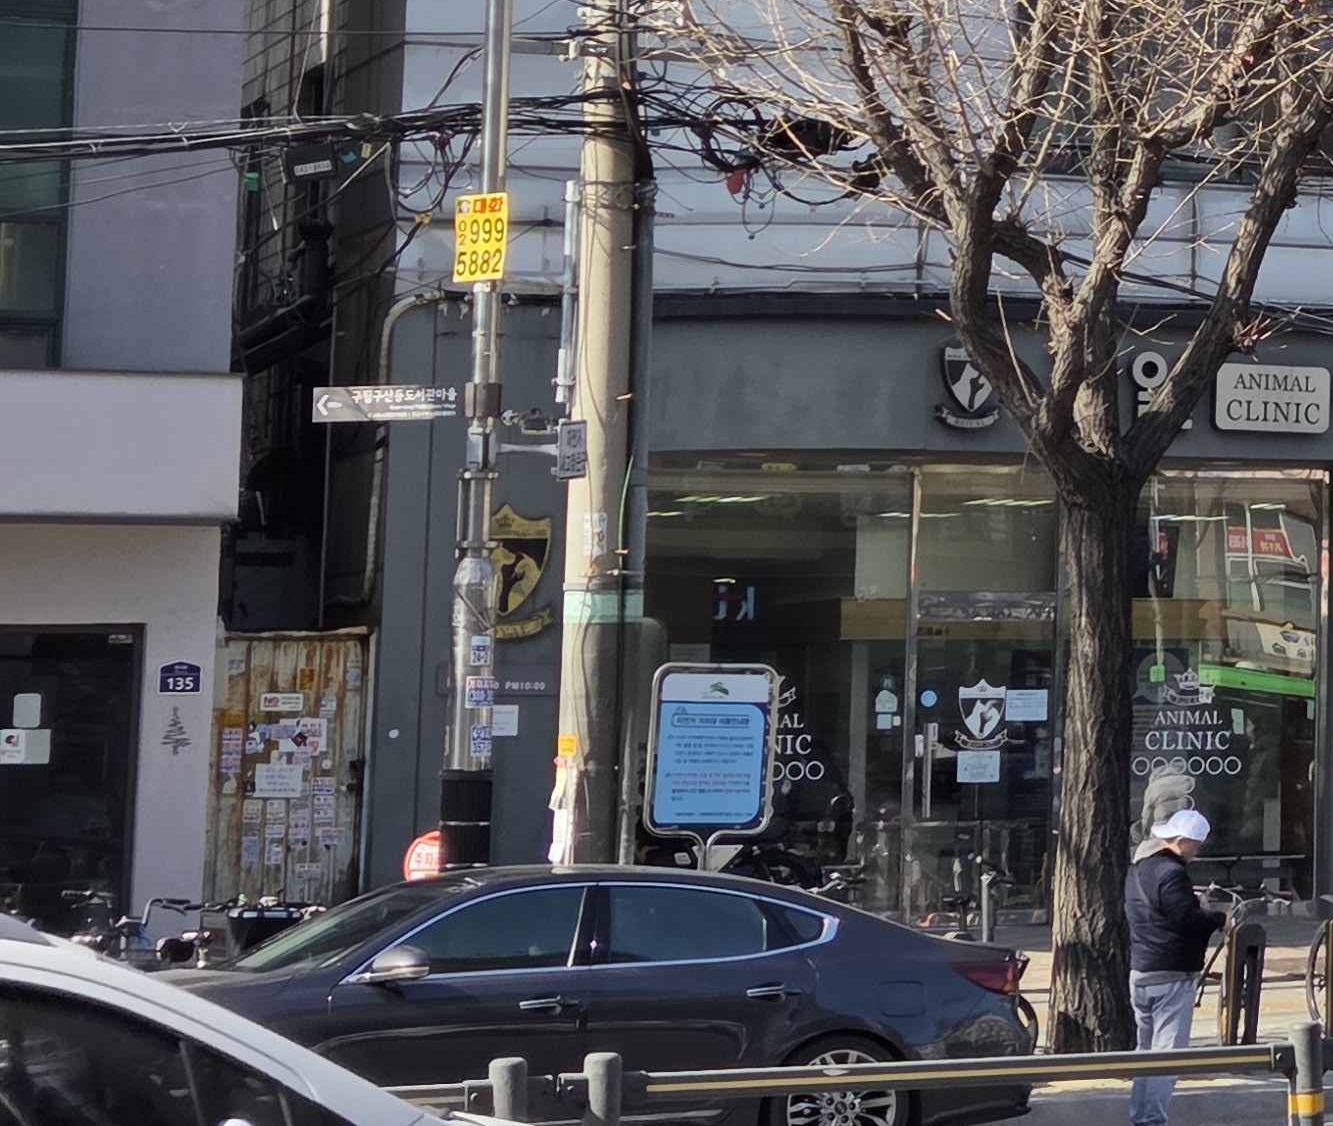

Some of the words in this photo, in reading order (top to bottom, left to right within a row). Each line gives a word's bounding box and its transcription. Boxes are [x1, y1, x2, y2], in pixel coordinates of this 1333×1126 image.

[456, 250, 503, 276] 5882
[1233, 371, 1316, 393] ANIMAL
[1226, 400, 1321, 425] CLINIC
[166, 676, 195, 690] 135
[1154, 709, 1223, 725] ANIMAL
[1144, 730, 1233, 751] CLINIC
